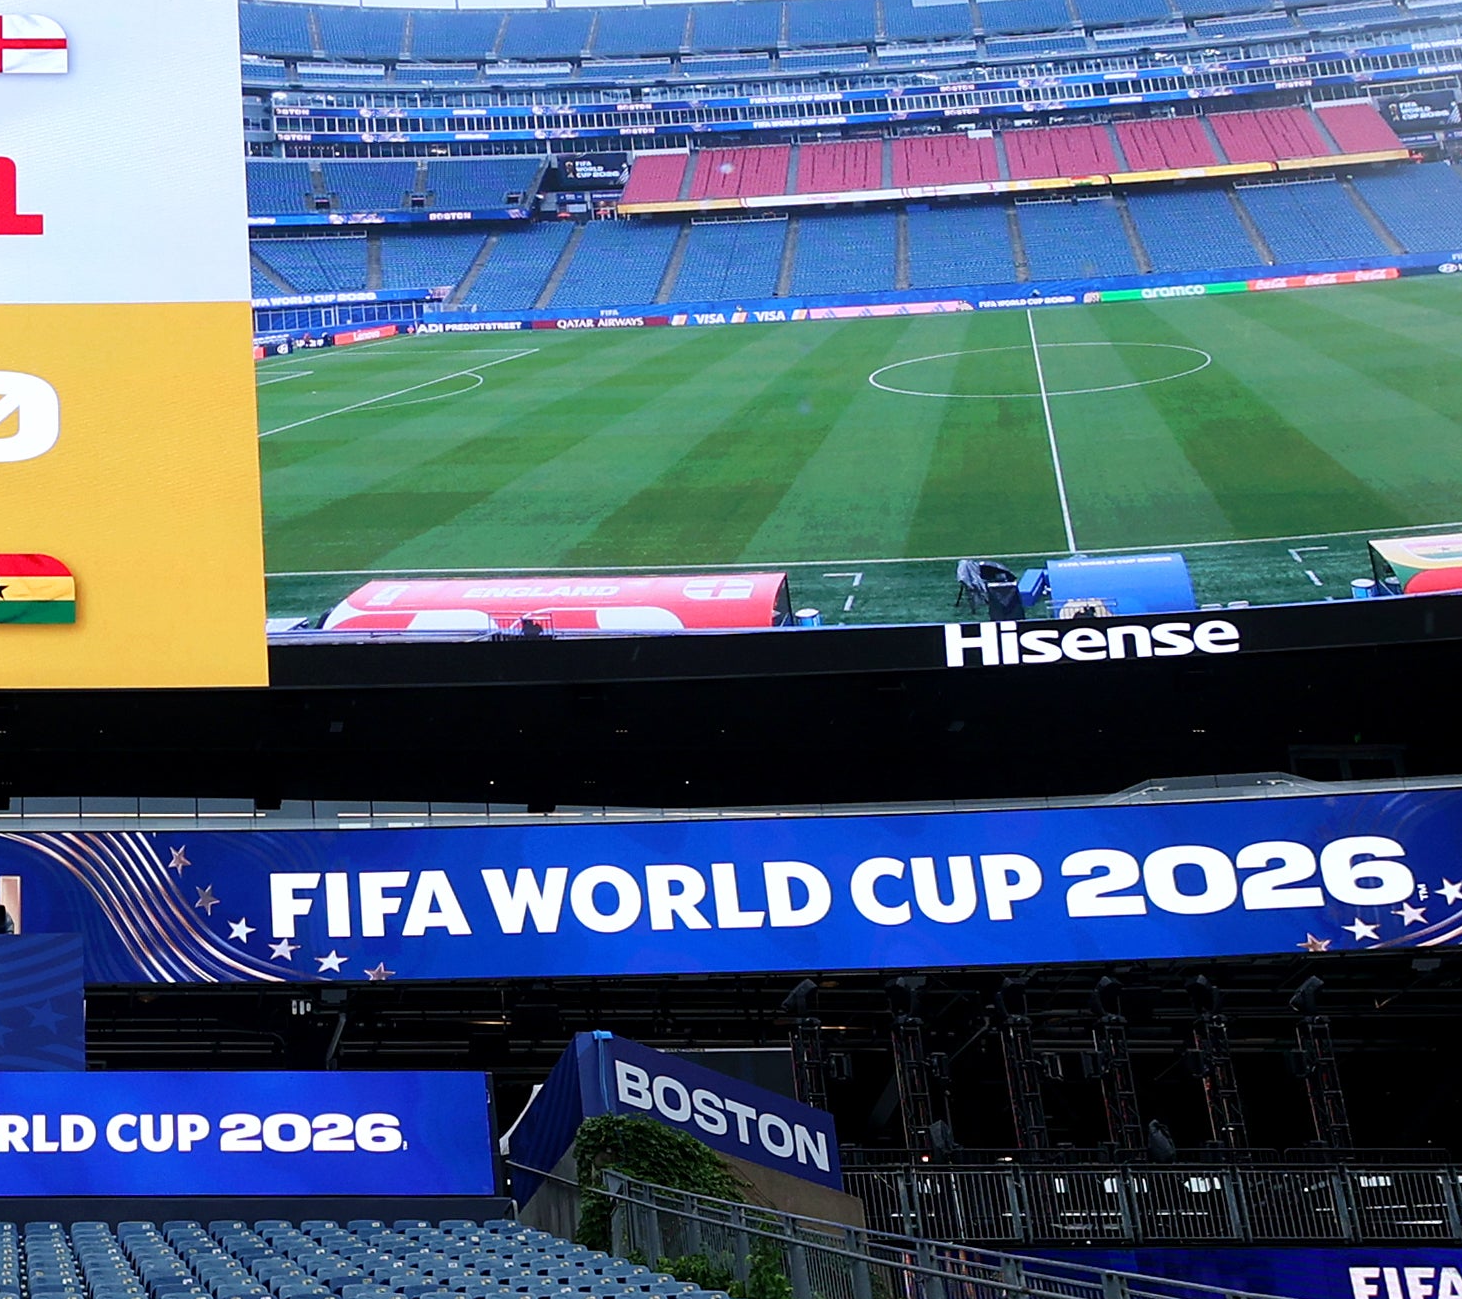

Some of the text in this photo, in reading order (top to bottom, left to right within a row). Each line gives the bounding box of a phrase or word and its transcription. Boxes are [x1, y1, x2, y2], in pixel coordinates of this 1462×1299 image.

[1141, 285, 1205, 298] aramco
[271, 295, 312, 306] WORLD
[314, 293, 336, 303] CUP
[694, 313, 725, 324] VISA
[754, 310, 786, 322] VISA
[557, 317, 644, 329] QATAR AIRWAYS
[464, 586, 621, 598] ENGLAND
[944, 620, 1240, 668] Hisense
[269, 870, 472, 938] FIFA
[481, 861, 831, 933] WORLD
[850, 854, 1042, 925] CUP
[1061, 836, 1415, 917] 2026
[614, 1060, 830, 1172] BOSTON
[106, 1114, 210, 1153] CUP
[219, 1113, 403, 1153] 2026
